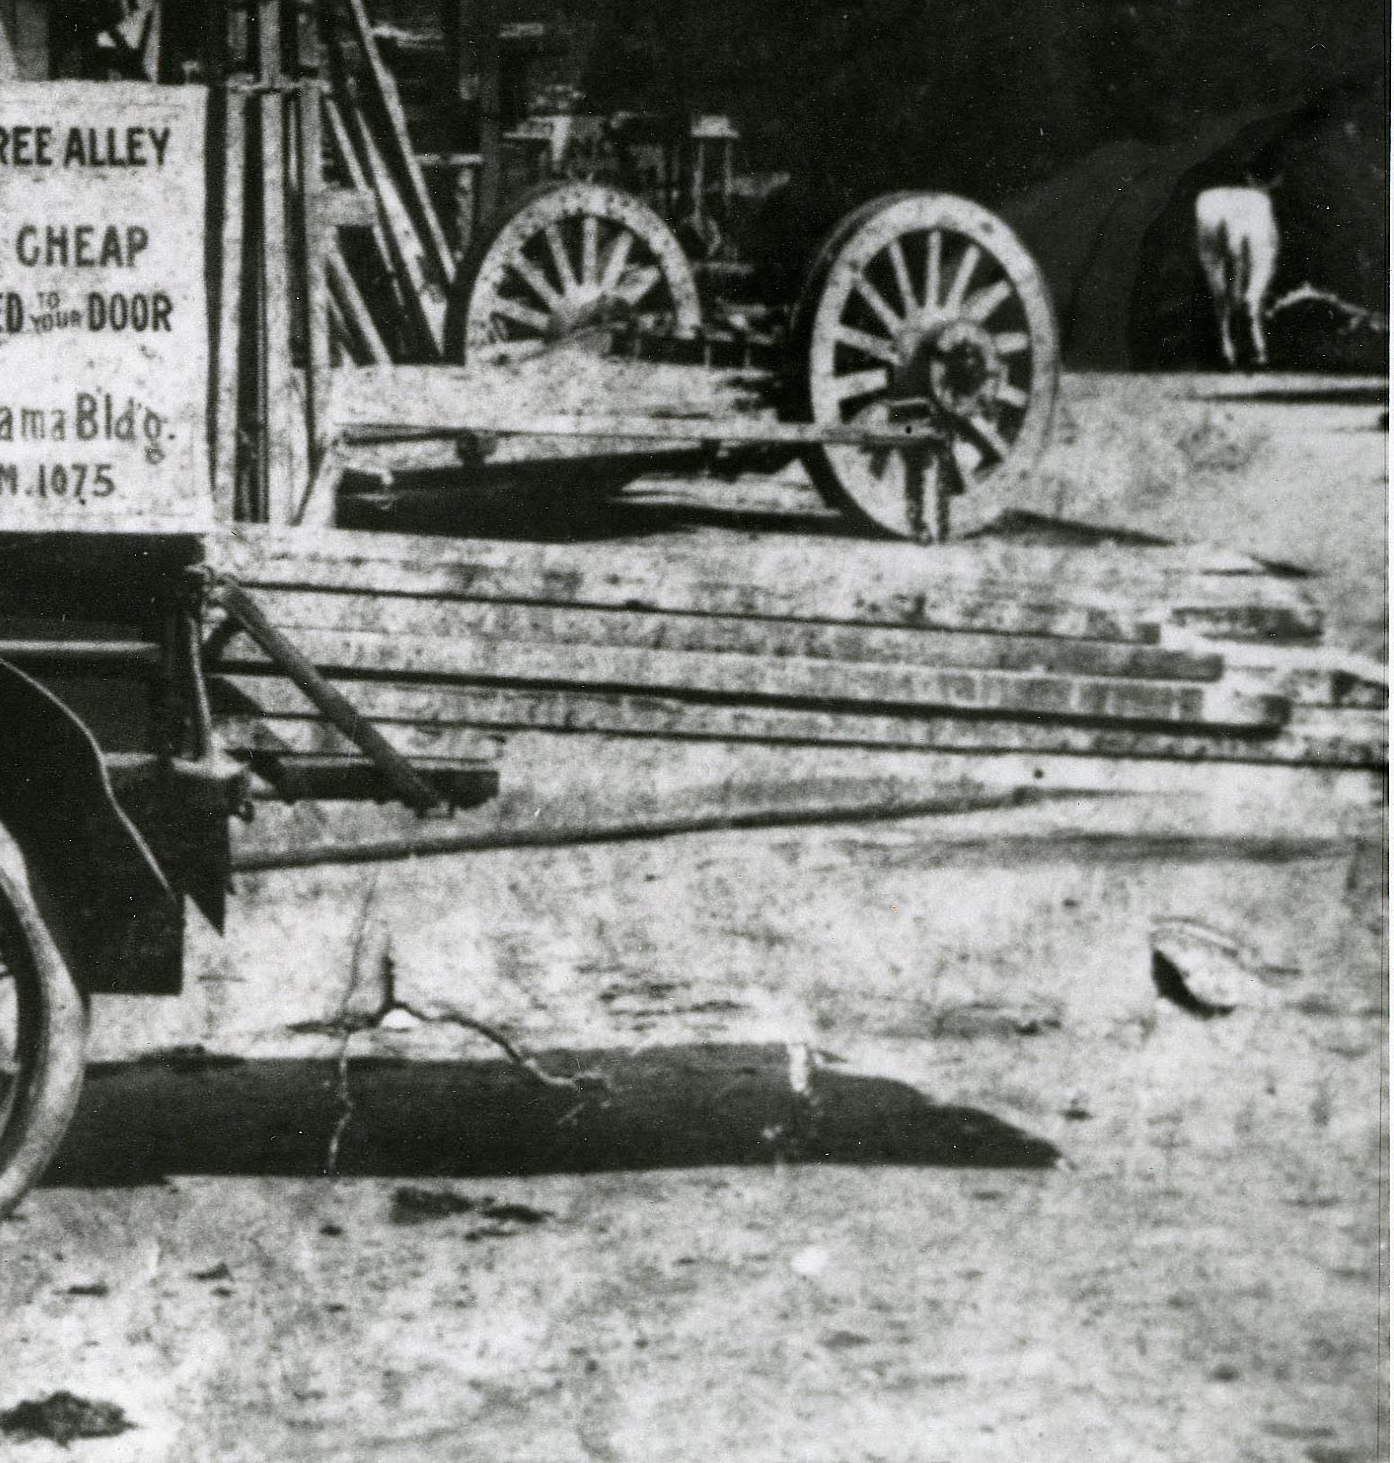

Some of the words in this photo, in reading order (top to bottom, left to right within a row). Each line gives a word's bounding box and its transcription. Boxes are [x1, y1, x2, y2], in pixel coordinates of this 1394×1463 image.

[64, 126, 172, 168] ALLEY
[15, 224, 150, 268] CHEAP
[37, 291, 61, 309] TO
[88, 291, 174, 333] DOOR
[36, 463, 116, 499] 1075
